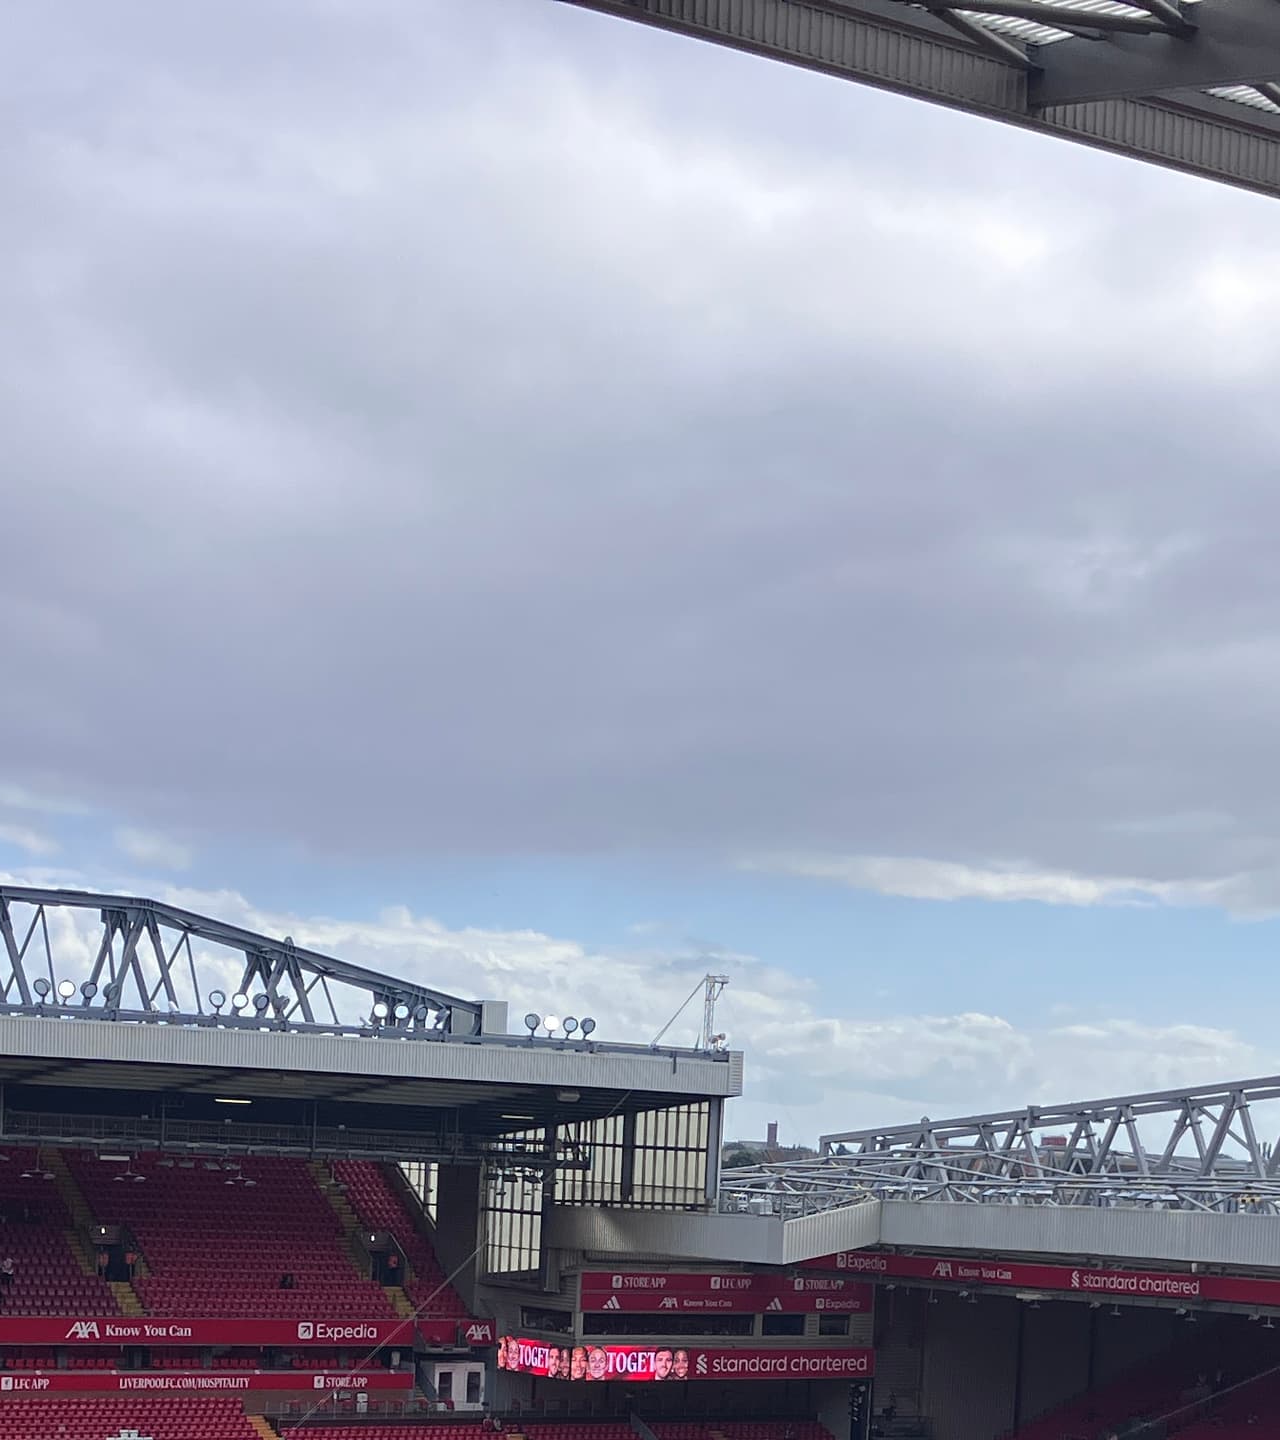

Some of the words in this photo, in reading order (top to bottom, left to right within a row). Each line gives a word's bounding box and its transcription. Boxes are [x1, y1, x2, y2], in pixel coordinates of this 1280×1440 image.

[847, 1254, 887, 1271] Expedia
[932, 1261, 953, 1277] AXA
[958, 1265, 980, 1277] Know
[981, 1267, 996, 1278] You
[997, 1268, 1012, 1280] Can
[623, 1277, 650, 1289] STORE
[650, 1277, 666, 1288] APP
[1083, 1272, 1137, 1291] standard
[1139, 1275, 1200, 1295] chartered
[658, 1297, 678, 1309] AXA
[683, 1299, 703, 1308] Know
[704, 1299, 718, 1308] You
[719, 1299, 733, 1308] Can
[825, 1298, 860, 1309] Expedia
[65, 1322, 100, 1339] AXA
[105, 1325, 141, 1337] Know
[143, 1325, 167, 1337] You
[168, 1325, 192, 1337] Can
[316, 1324, 377, 1341] Expedia
[465, 1324, 492, 1341] AXA
[712, 1356, 787, 1374] standard
[790, 1355, 868, 1372] chartered
[14, 1378, 30, 1390] LFC
[31, 1378, 50, 1389] APP
[119, 1377, 250, 1390] LIVERPOOLFC.COM/HOSPITALITY
[325, 1377, 351, 1388] STORE
[351, 1377, 368, 1387] APP
